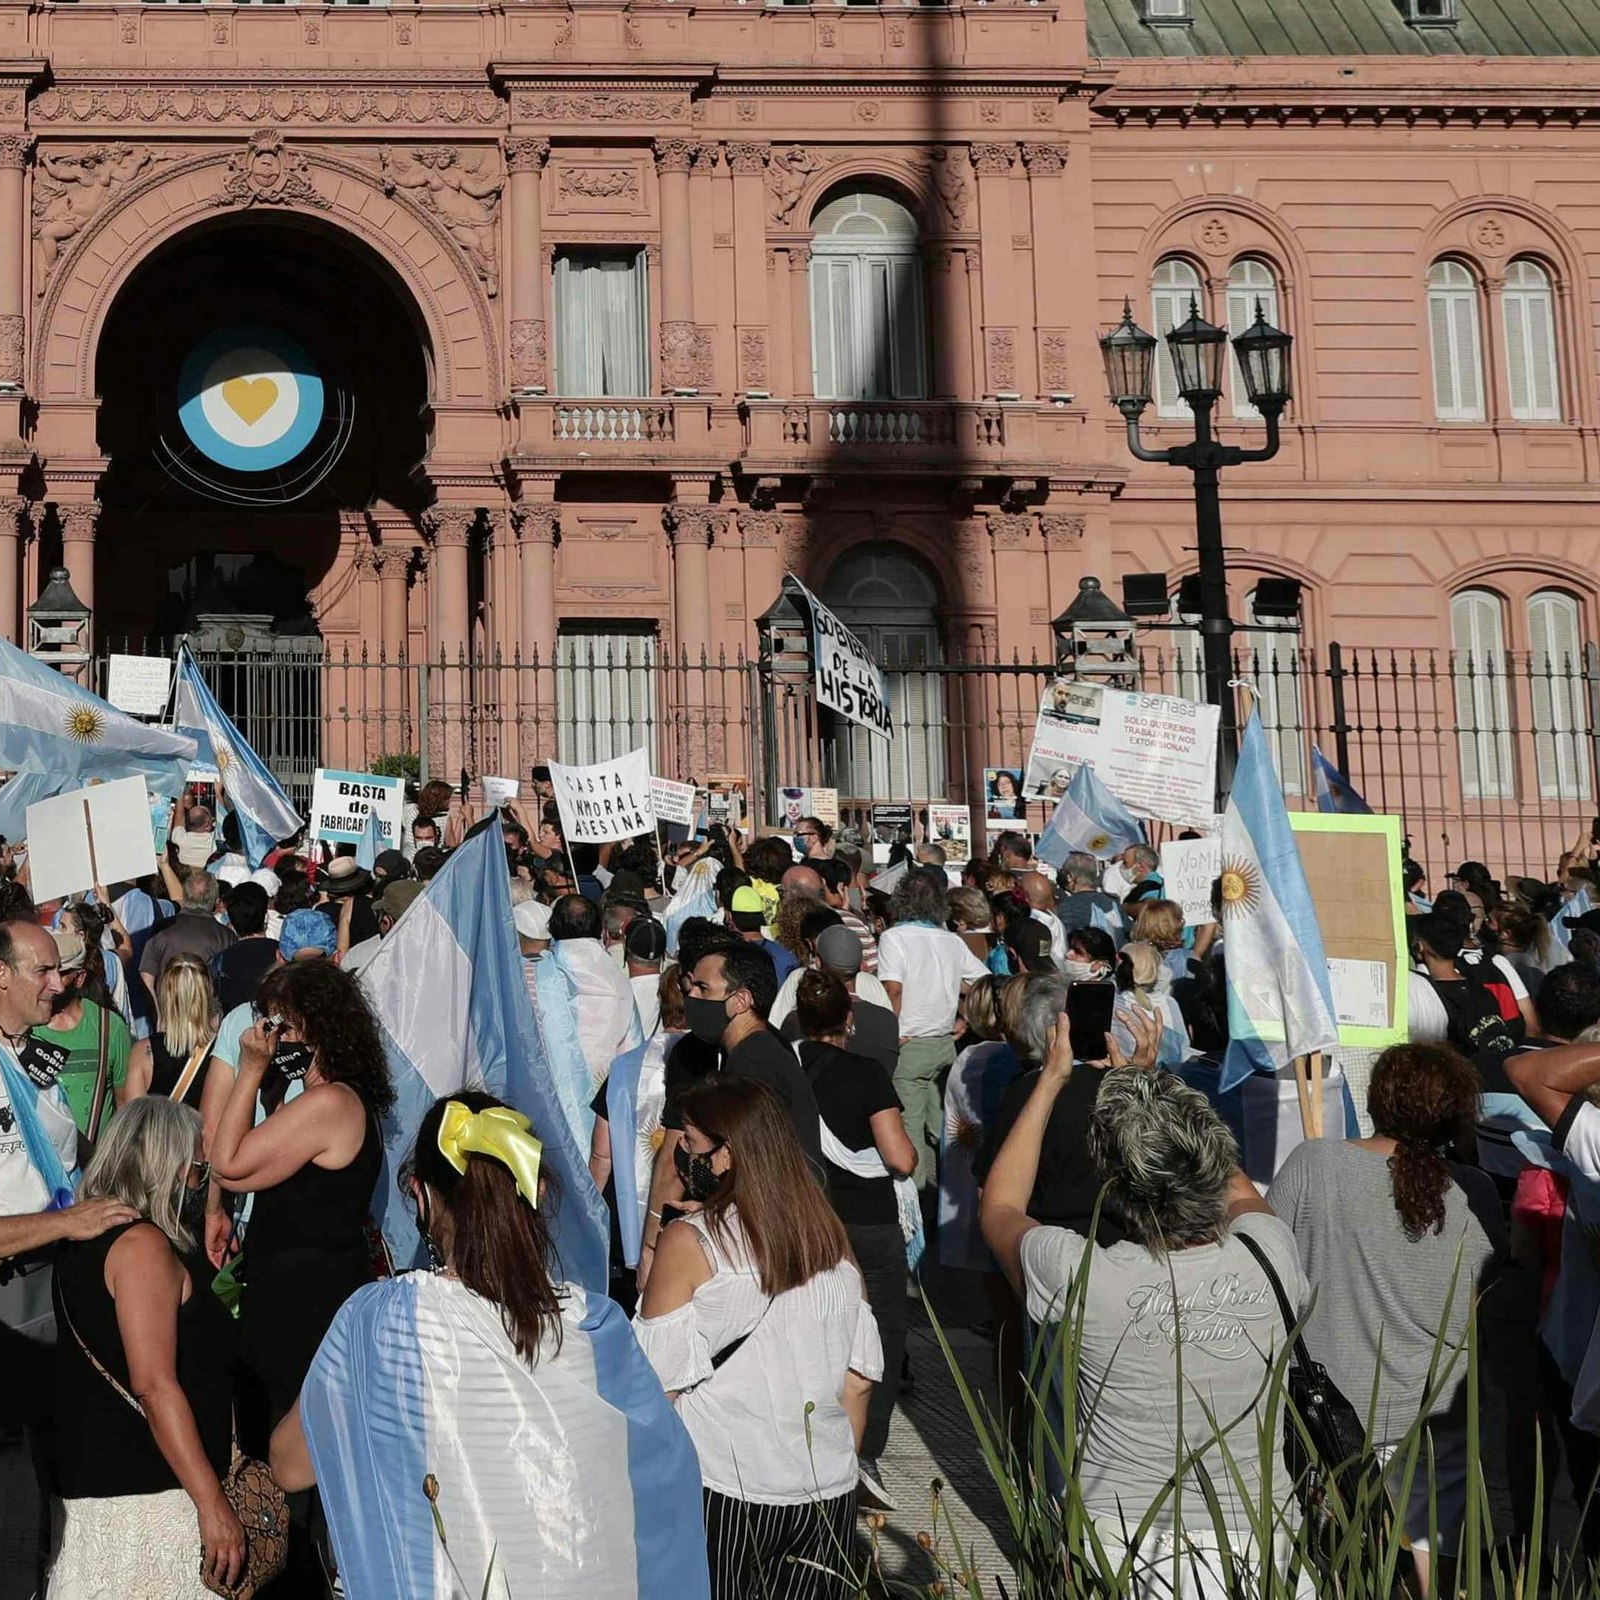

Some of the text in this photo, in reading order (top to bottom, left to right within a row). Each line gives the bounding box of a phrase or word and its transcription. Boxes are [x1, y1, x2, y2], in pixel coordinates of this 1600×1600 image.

[833, 652, 877, 695] DE LA
[820, 667, 894, 740] HISTORIA
[1140, 696, 1196, 718] senasa
[1124, 715, 1149, 727] SOLO
[339, 782, 386, 801] BASTA
[349, 801, 369, 814] de
[569, 793, 638, 817] INMORAL
[320, 814, 363, 833] FABRICAR
[575, 811, 646, 836] ASESINA
